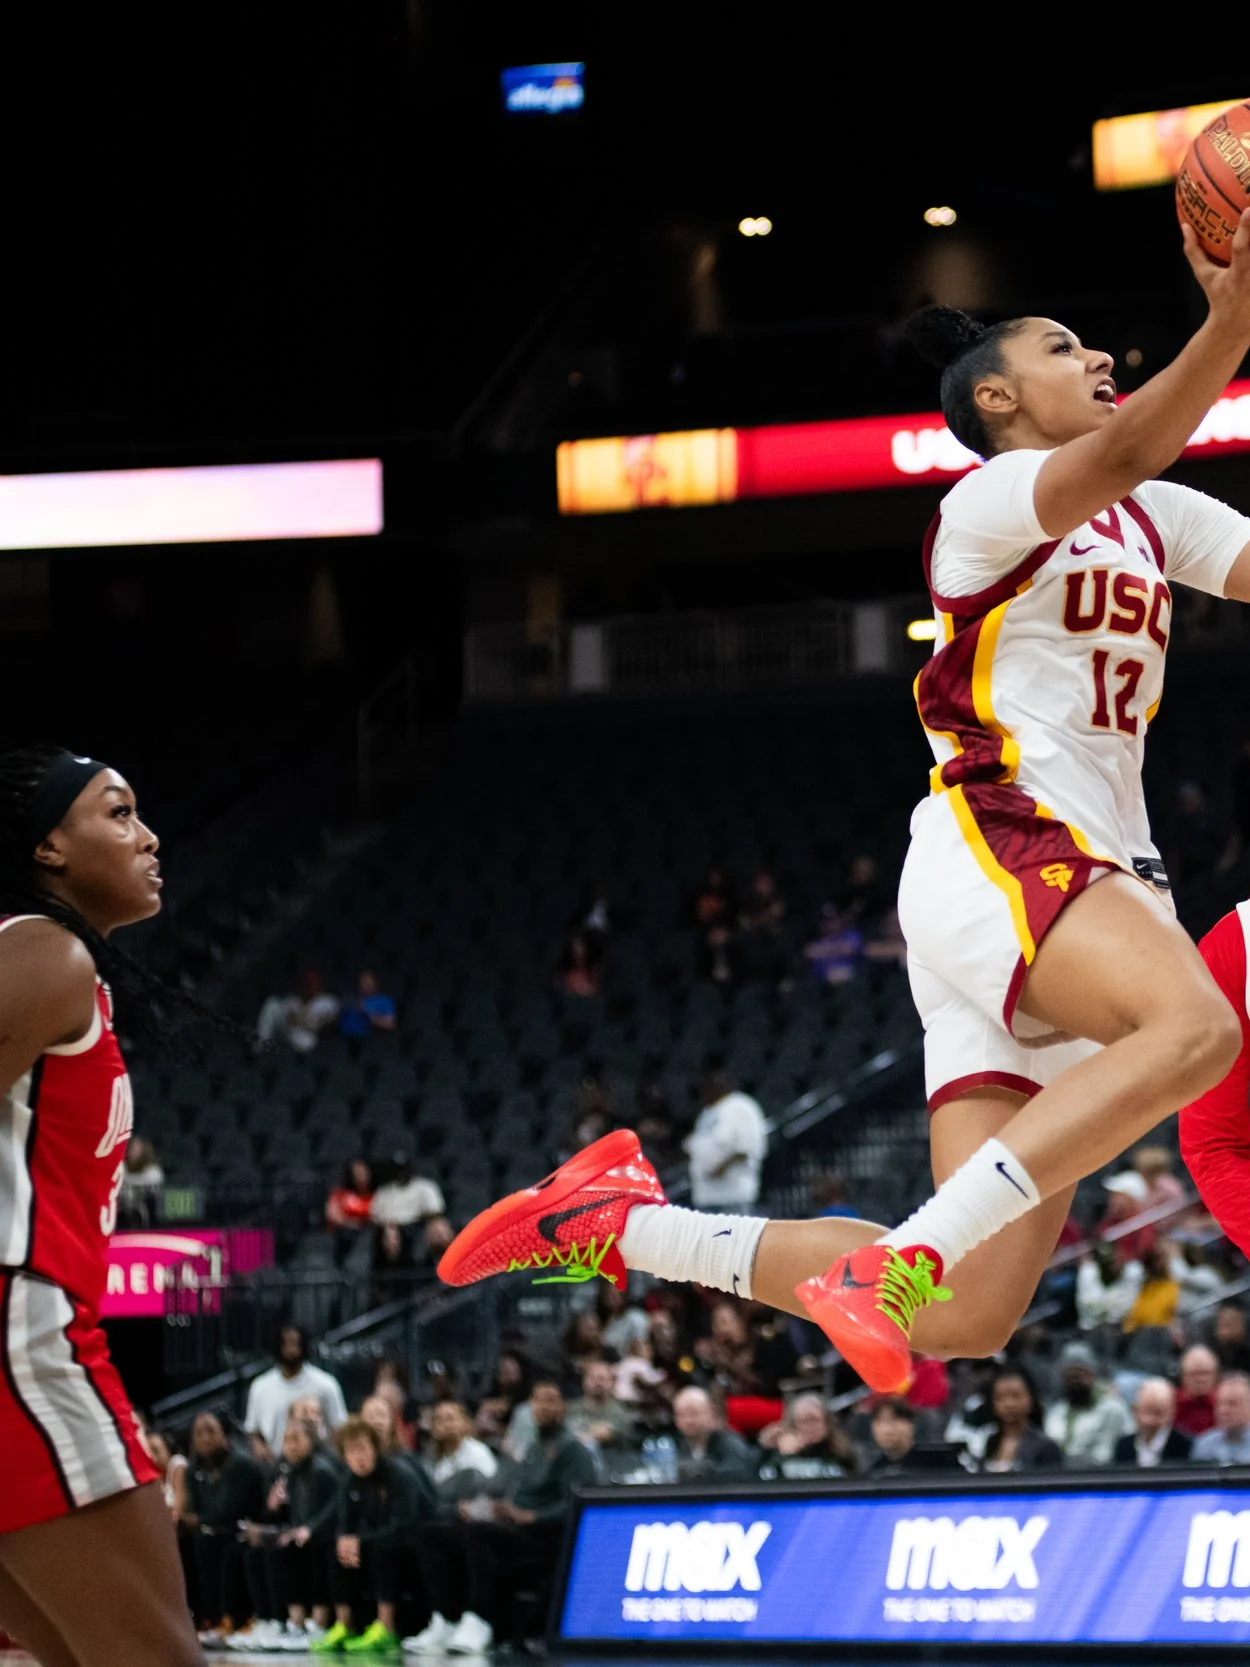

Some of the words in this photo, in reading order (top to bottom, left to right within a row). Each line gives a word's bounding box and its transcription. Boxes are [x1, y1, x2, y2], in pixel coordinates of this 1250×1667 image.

[1063, 567, 1172, 652] USC
[1090, 648, 1145, 736] 12
[107, 1262, 200, 1296] RENA
[624, 1521, 773, 1592] max
[885, 1516, 1048, 1591] max
